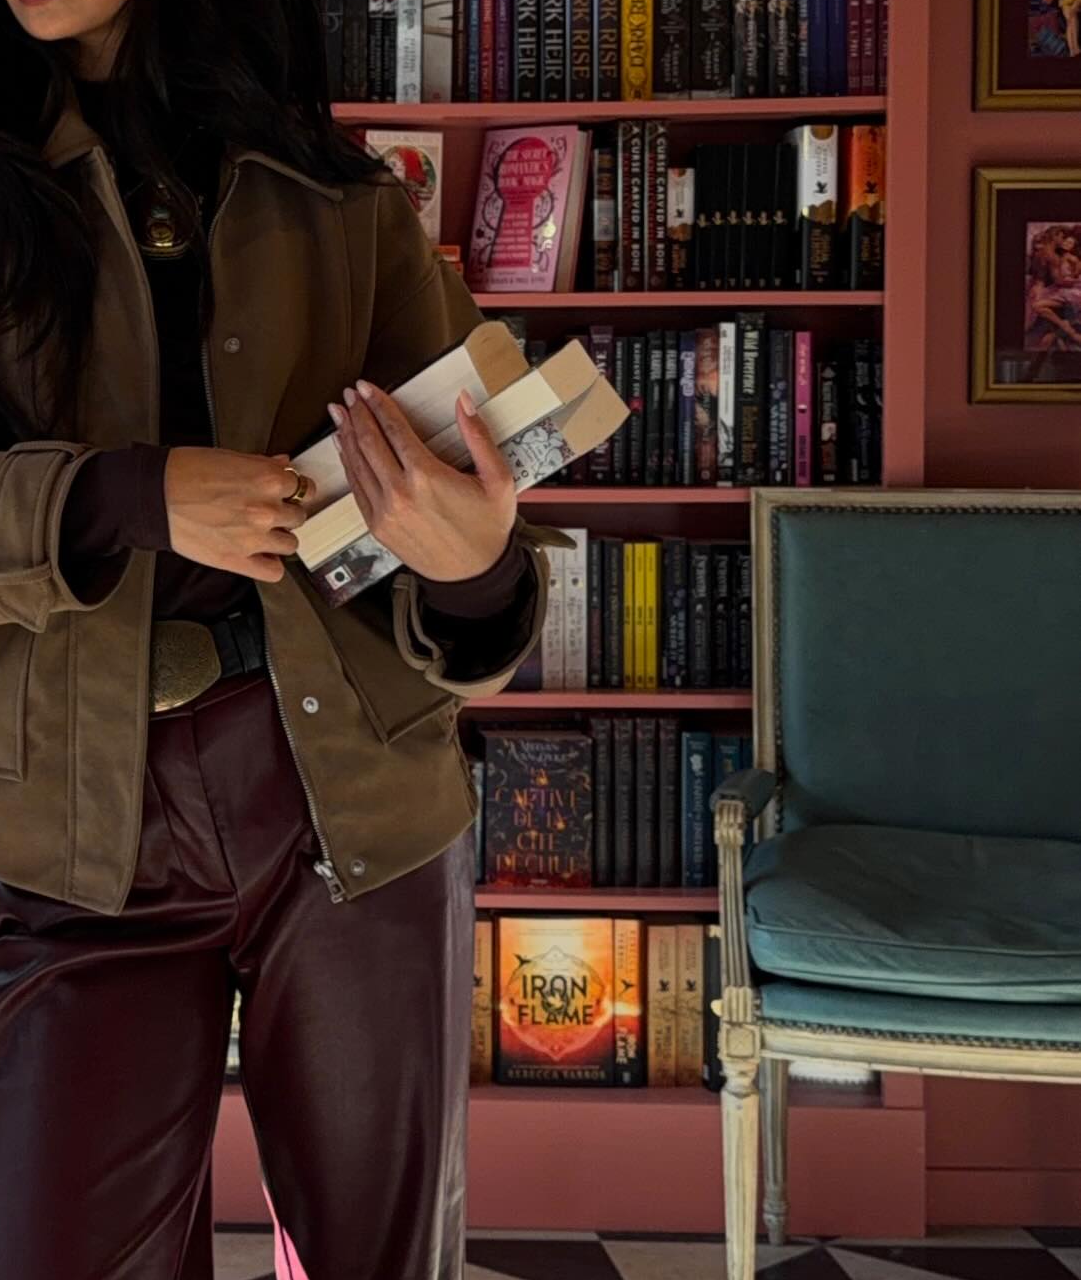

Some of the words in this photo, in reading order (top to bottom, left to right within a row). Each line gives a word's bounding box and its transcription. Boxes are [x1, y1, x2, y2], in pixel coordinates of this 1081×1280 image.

[518, 28, 536, 79] HEIR
[545, 29, 563, 80] HEIR
[572, 30, 590, 80] RISE
[599, 28, 617, 78] RISE
[630, 23, 645, 68] DARK
[631, 138, 641, 174] CURSE
[656, 138, 666, 174] CURSE
[631, 178, 641, 225] CARVED
[656, 178, 666, 225] CARVED
[631, 229, 641, 239] IN
[656, 229, 666, 239] IN
[631, 243, 641, 272] BONE
[656, 243, 666, 272] BONE
[742, 330, 760, 350] Wild
[522, 975, 587, 1000] IRON
[518, 1004, 594, 1026] FLAME
